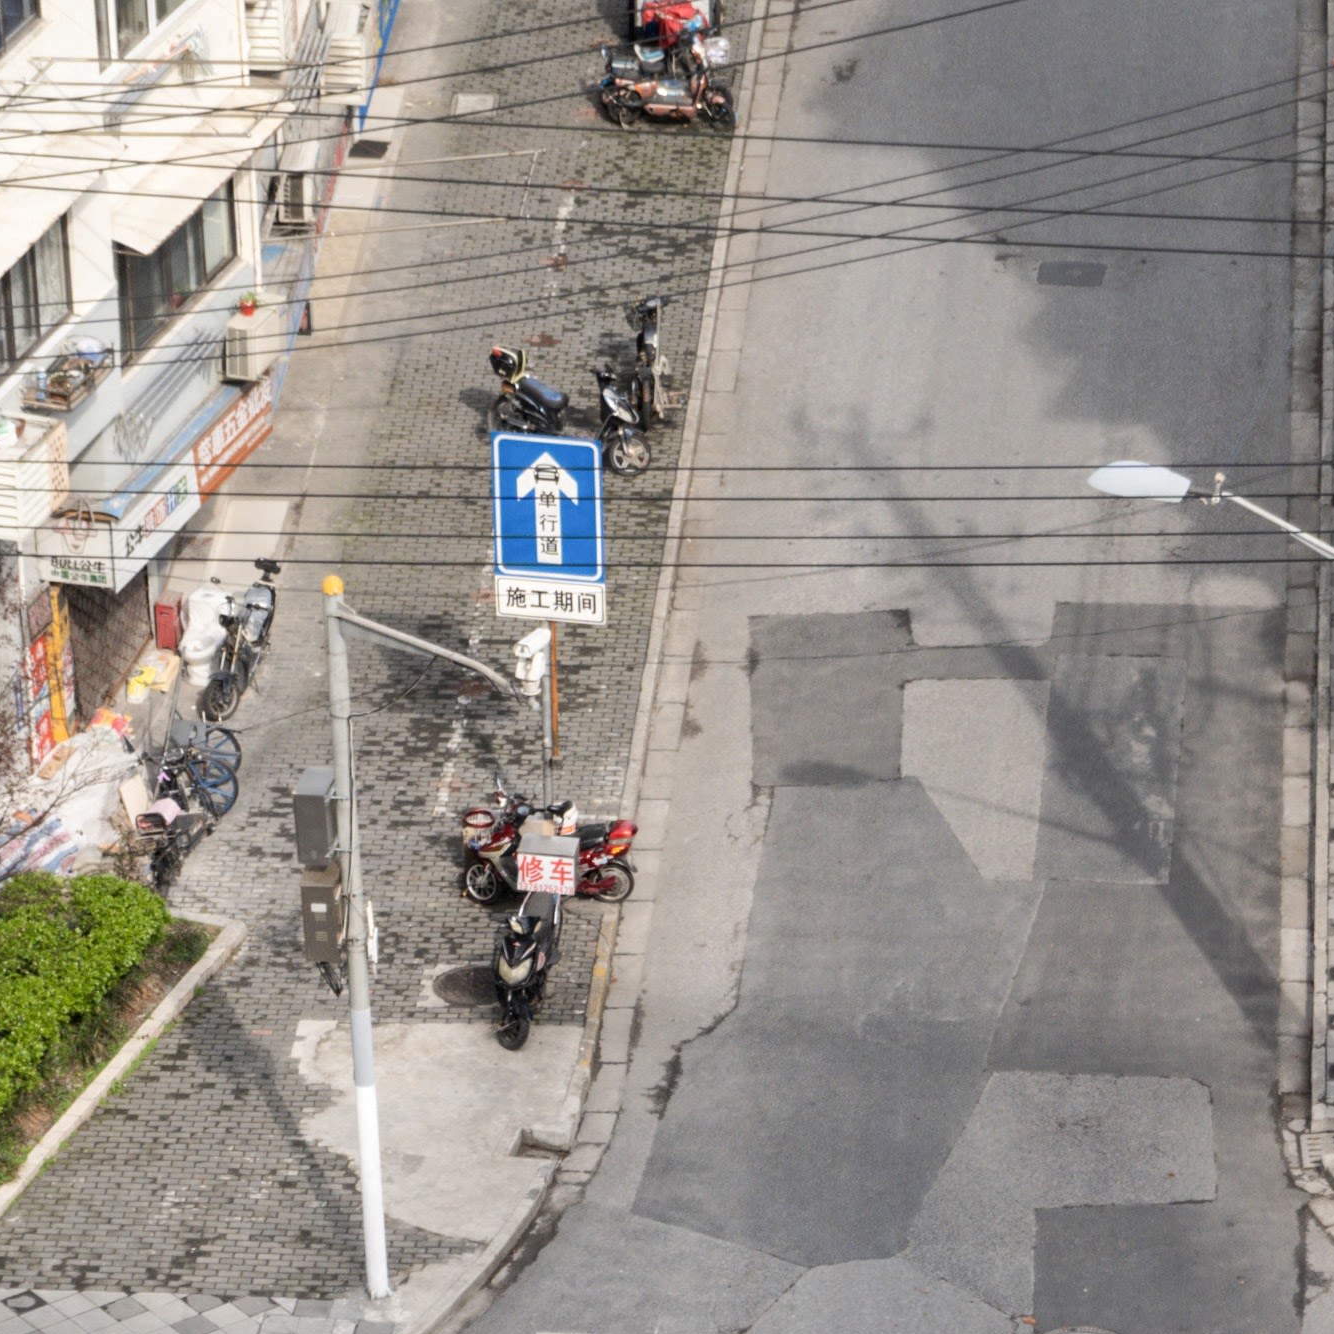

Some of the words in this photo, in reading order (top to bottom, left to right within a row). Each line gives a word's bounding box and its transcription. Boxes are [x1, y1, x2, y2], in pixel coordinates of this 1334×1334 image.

[539, 490, 560, 556] 单行道
[506, 585, 597, 615] 施工期间
[519, 855, 574, 885] 修车
